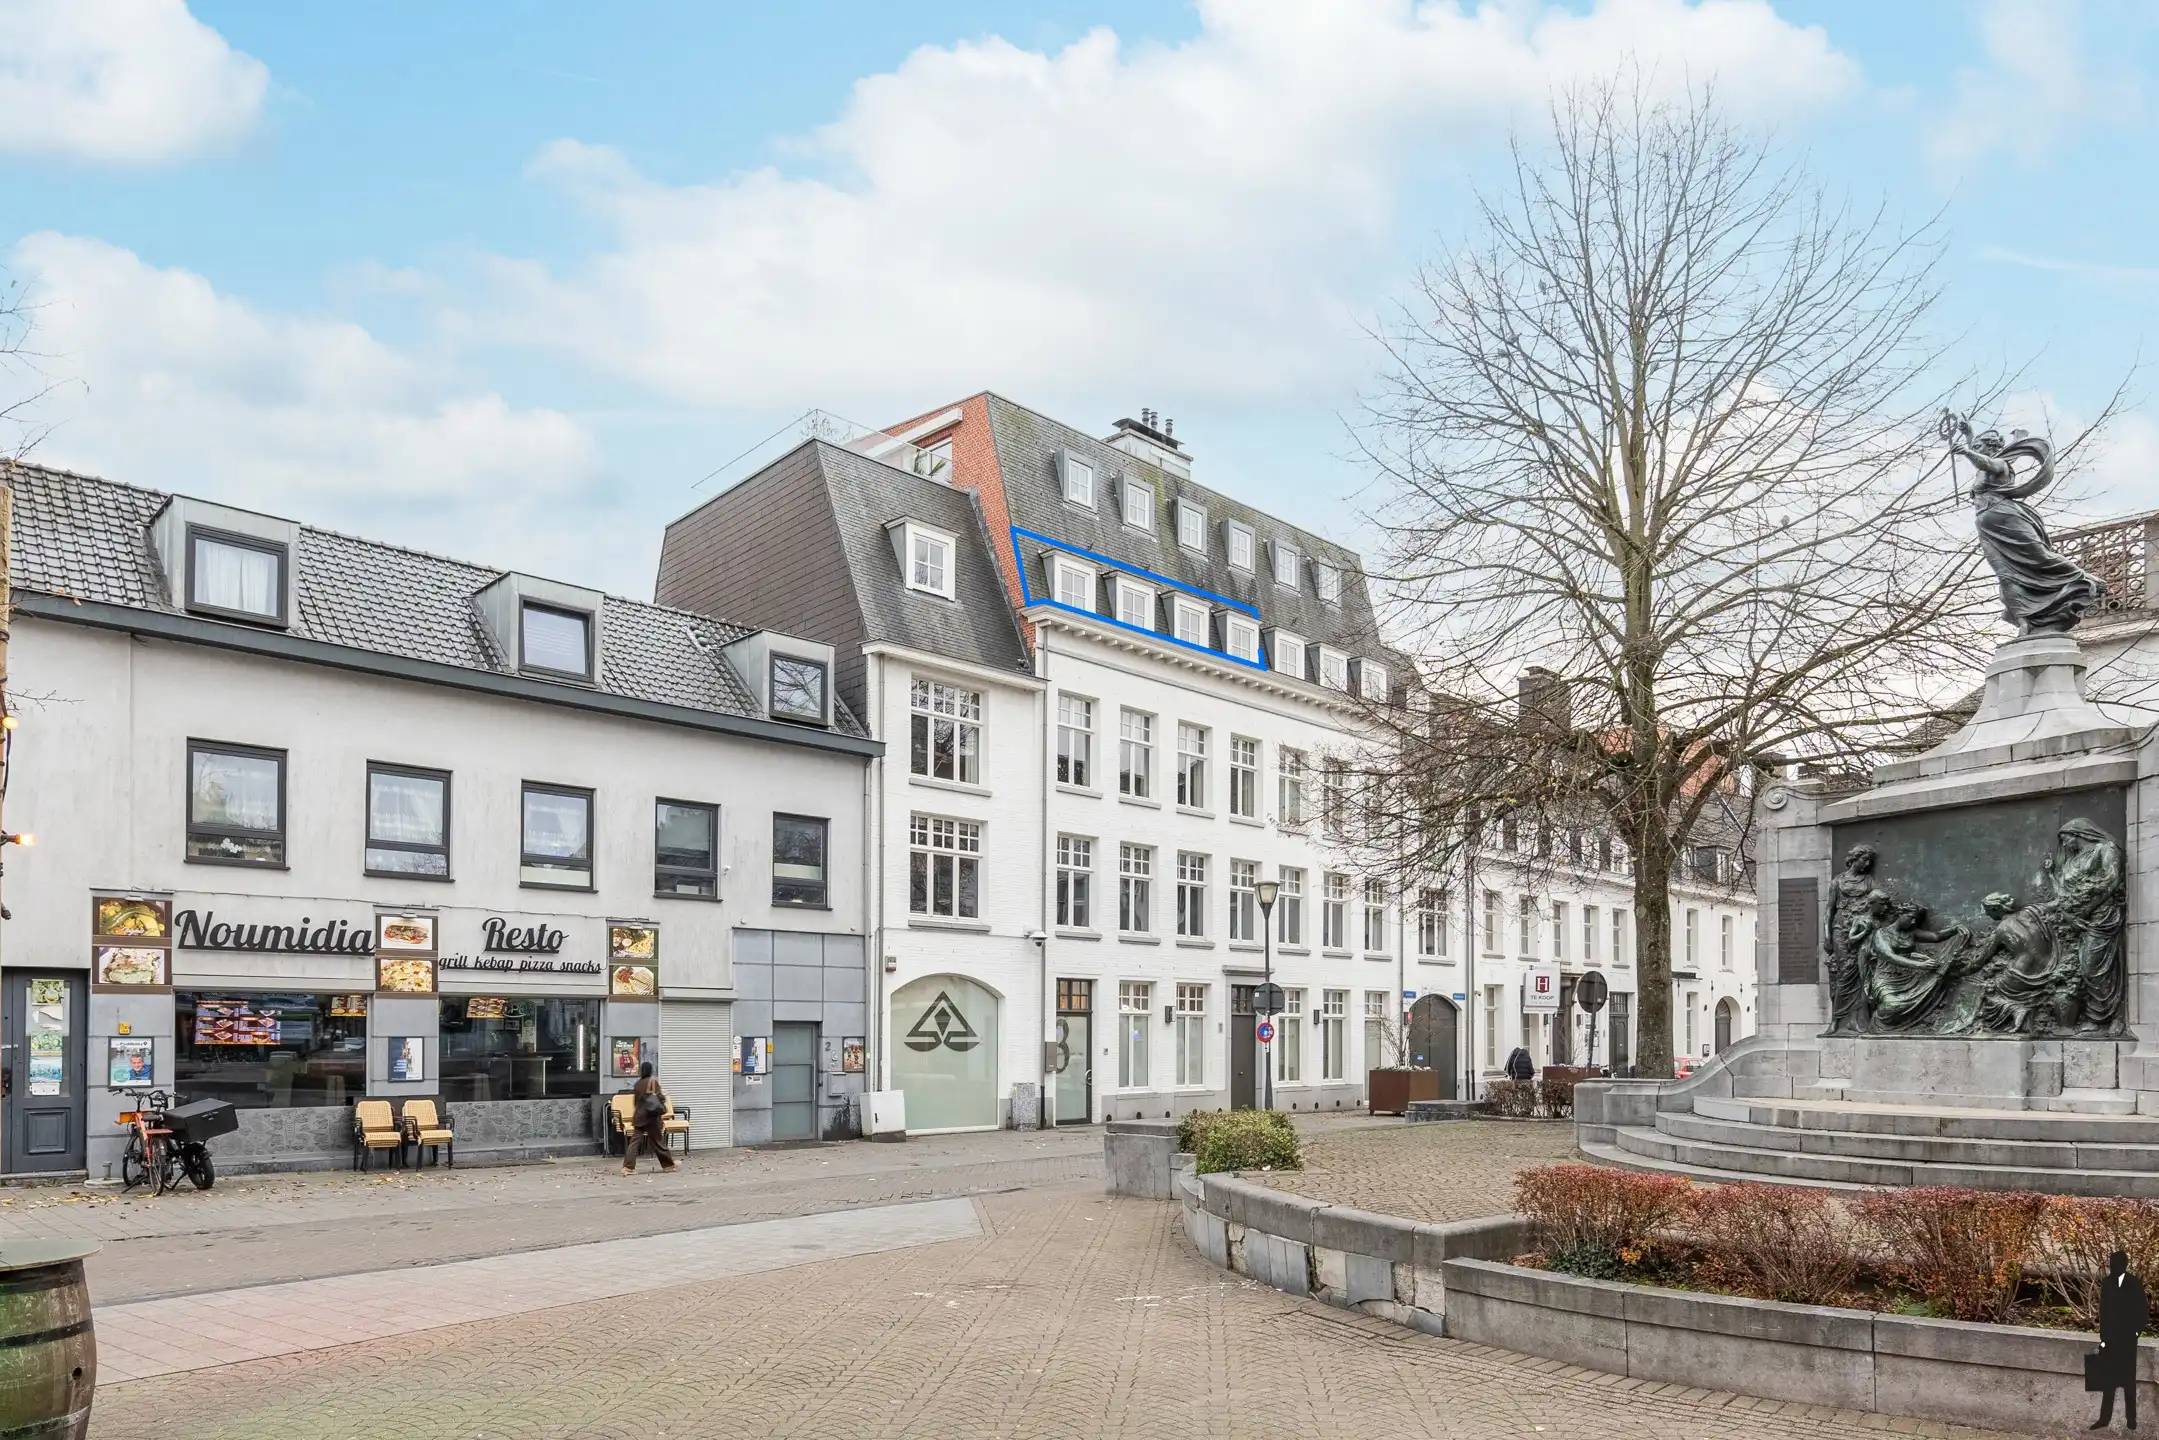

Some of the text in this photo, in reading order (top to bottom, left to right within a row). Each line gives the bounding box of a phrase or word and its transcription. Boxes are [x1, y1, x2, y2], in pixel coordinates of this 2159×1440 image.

[174, 909, 376, 954] Noumidia
[482, 917, 569, 952] Resto
[438, 952, 602, 974] grill kebap pizza snacks
